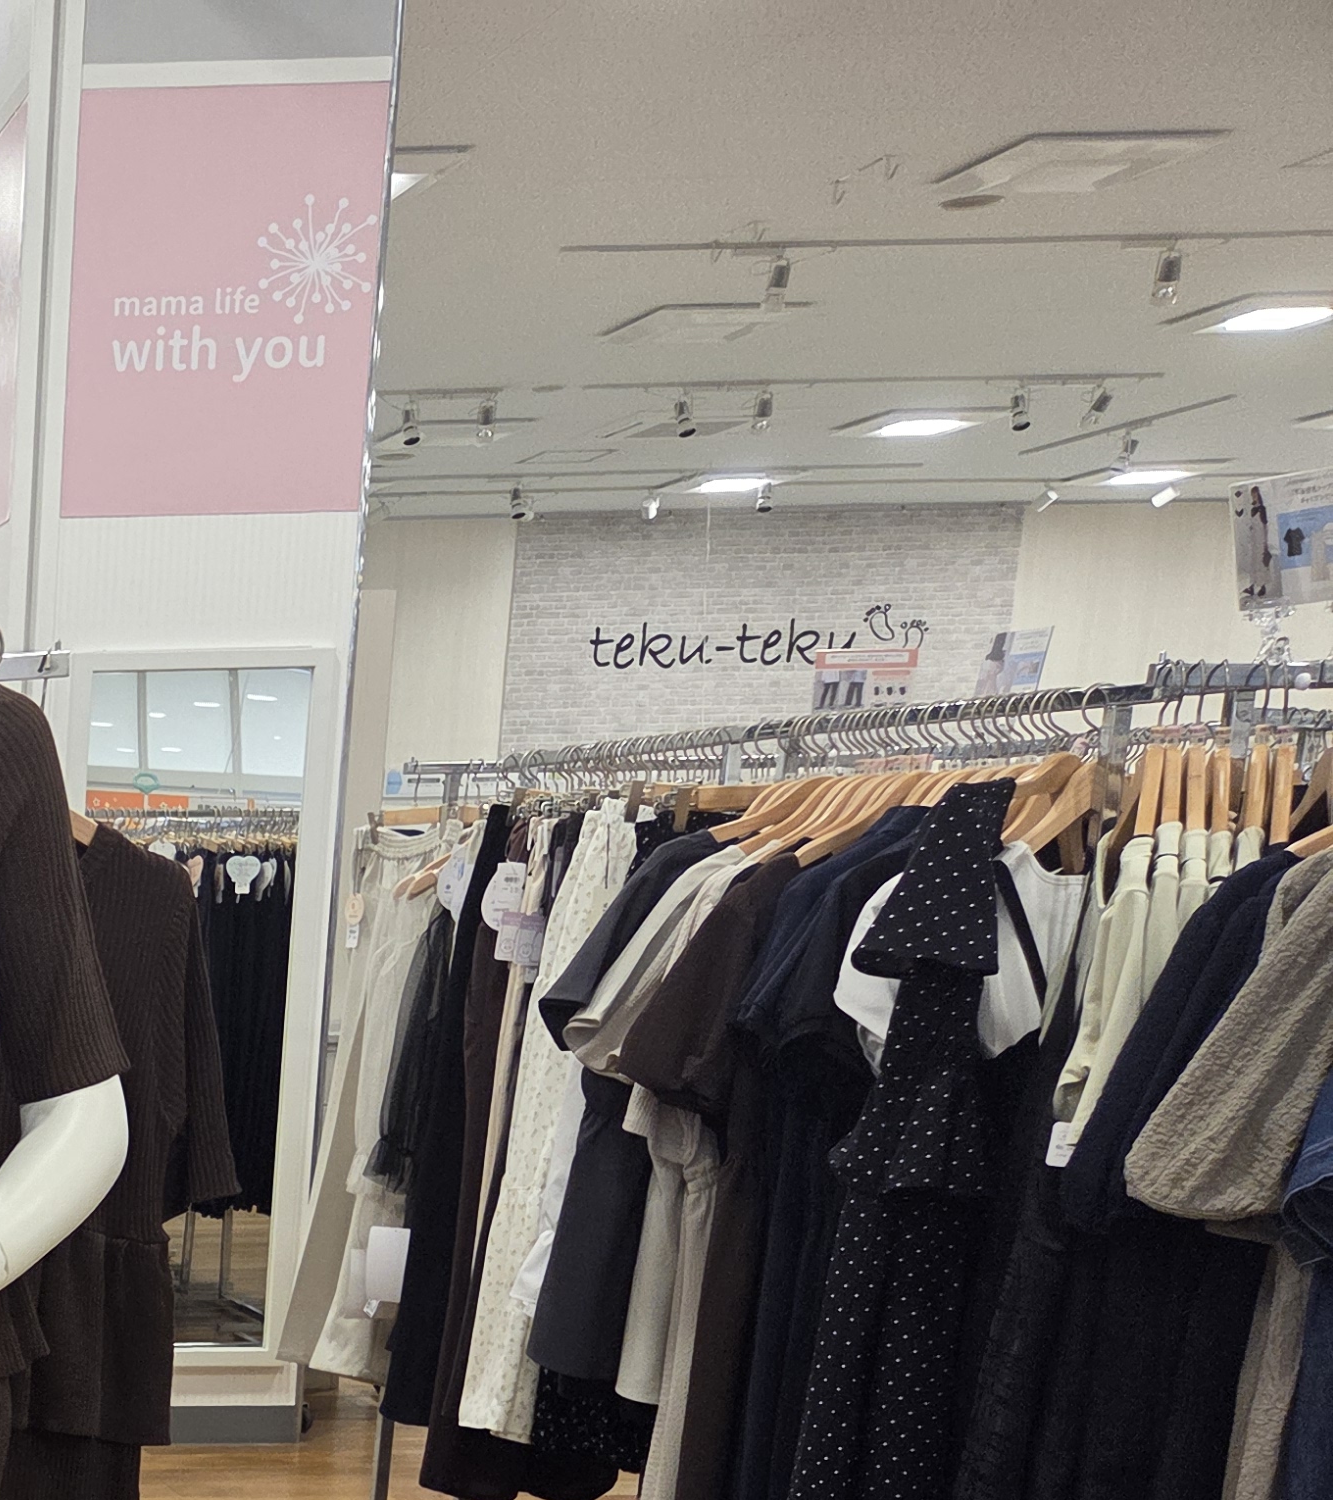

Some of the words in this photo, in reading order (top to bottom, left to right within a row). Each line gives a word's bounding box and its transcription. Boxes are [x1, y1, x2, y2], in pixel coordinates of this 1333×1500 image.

[113, 295, 204, 317] mama
[214, 285, 260, 315] life
[111, 324, 217, 373] with
[232, 334, 326, 383] you
